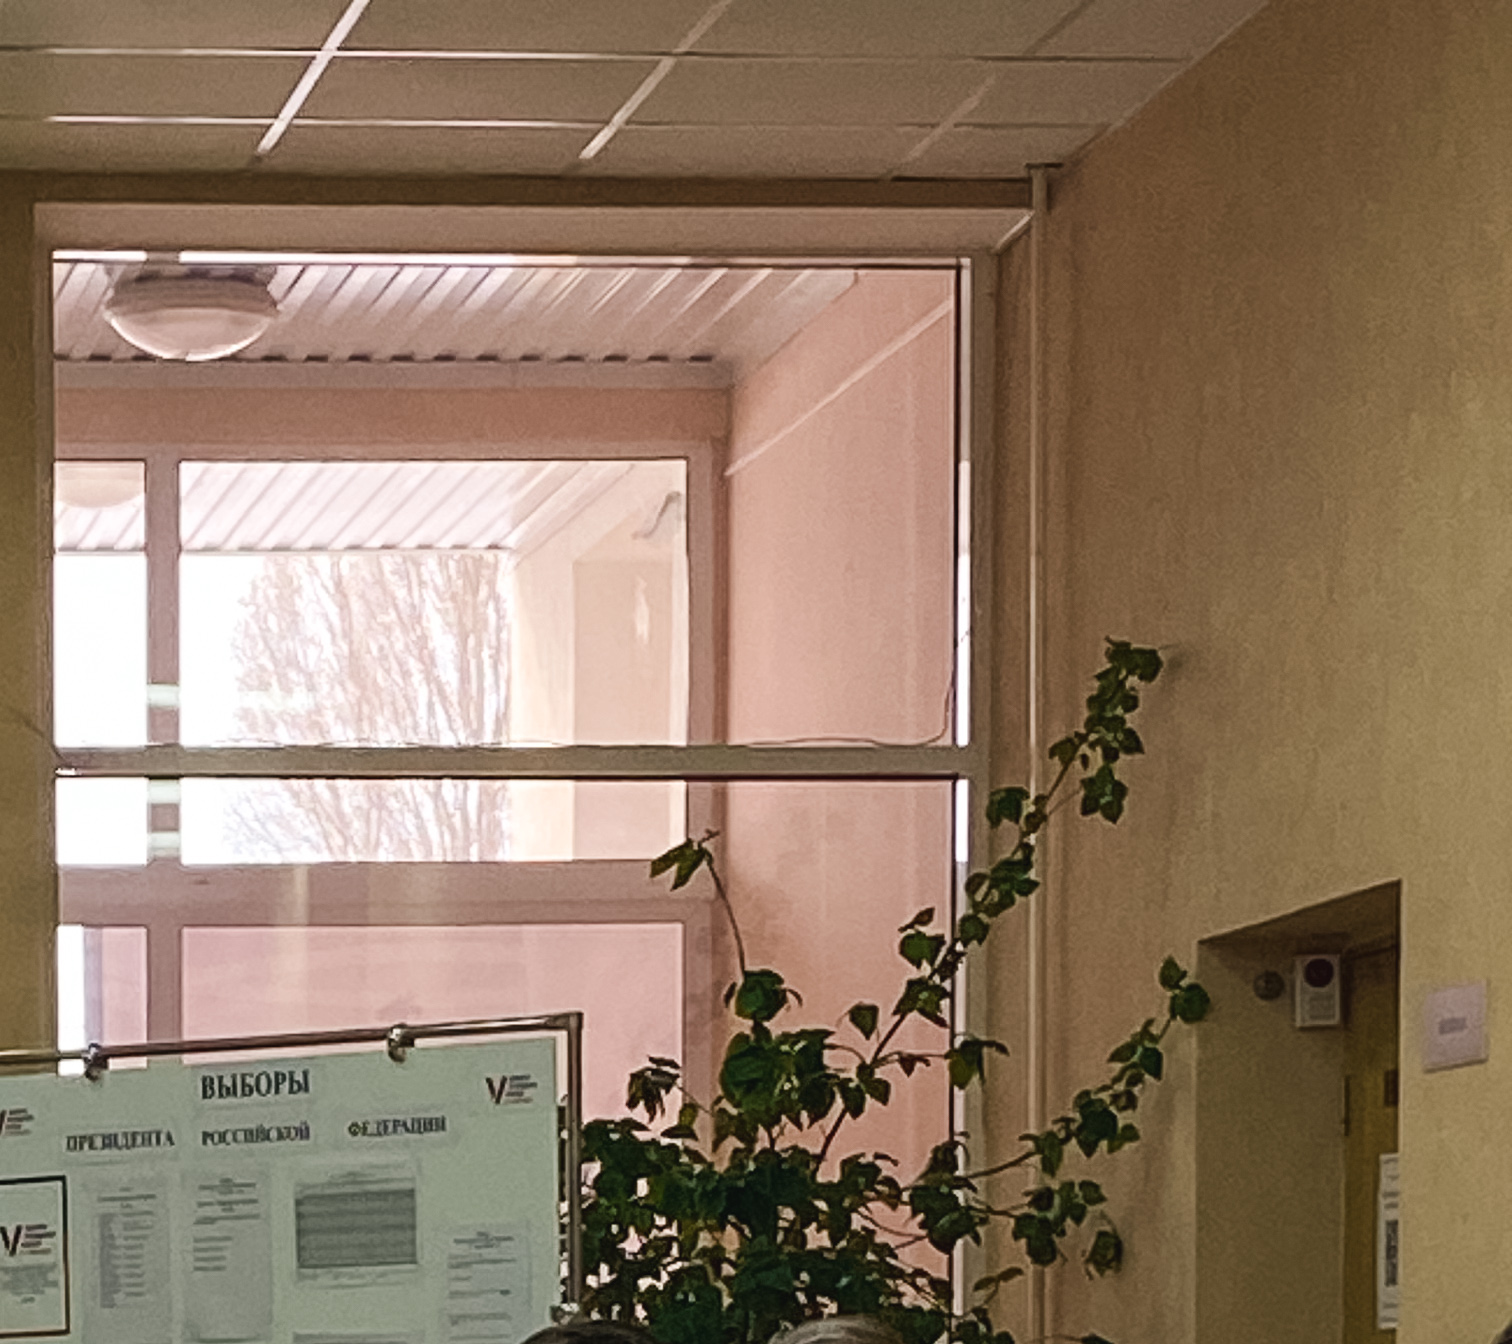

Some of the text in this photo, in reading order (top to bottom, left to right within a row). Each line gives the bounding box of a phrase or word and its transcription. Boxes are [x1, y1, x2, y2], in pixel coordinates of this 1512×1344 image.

[201, 1070, 310, 1099] ВЫБОРЫ
[65, 1115, 447, 1152] ПРЕЗИДЕНТА РОССИЙСКОЙ ФЕДЕРАЦИИ
